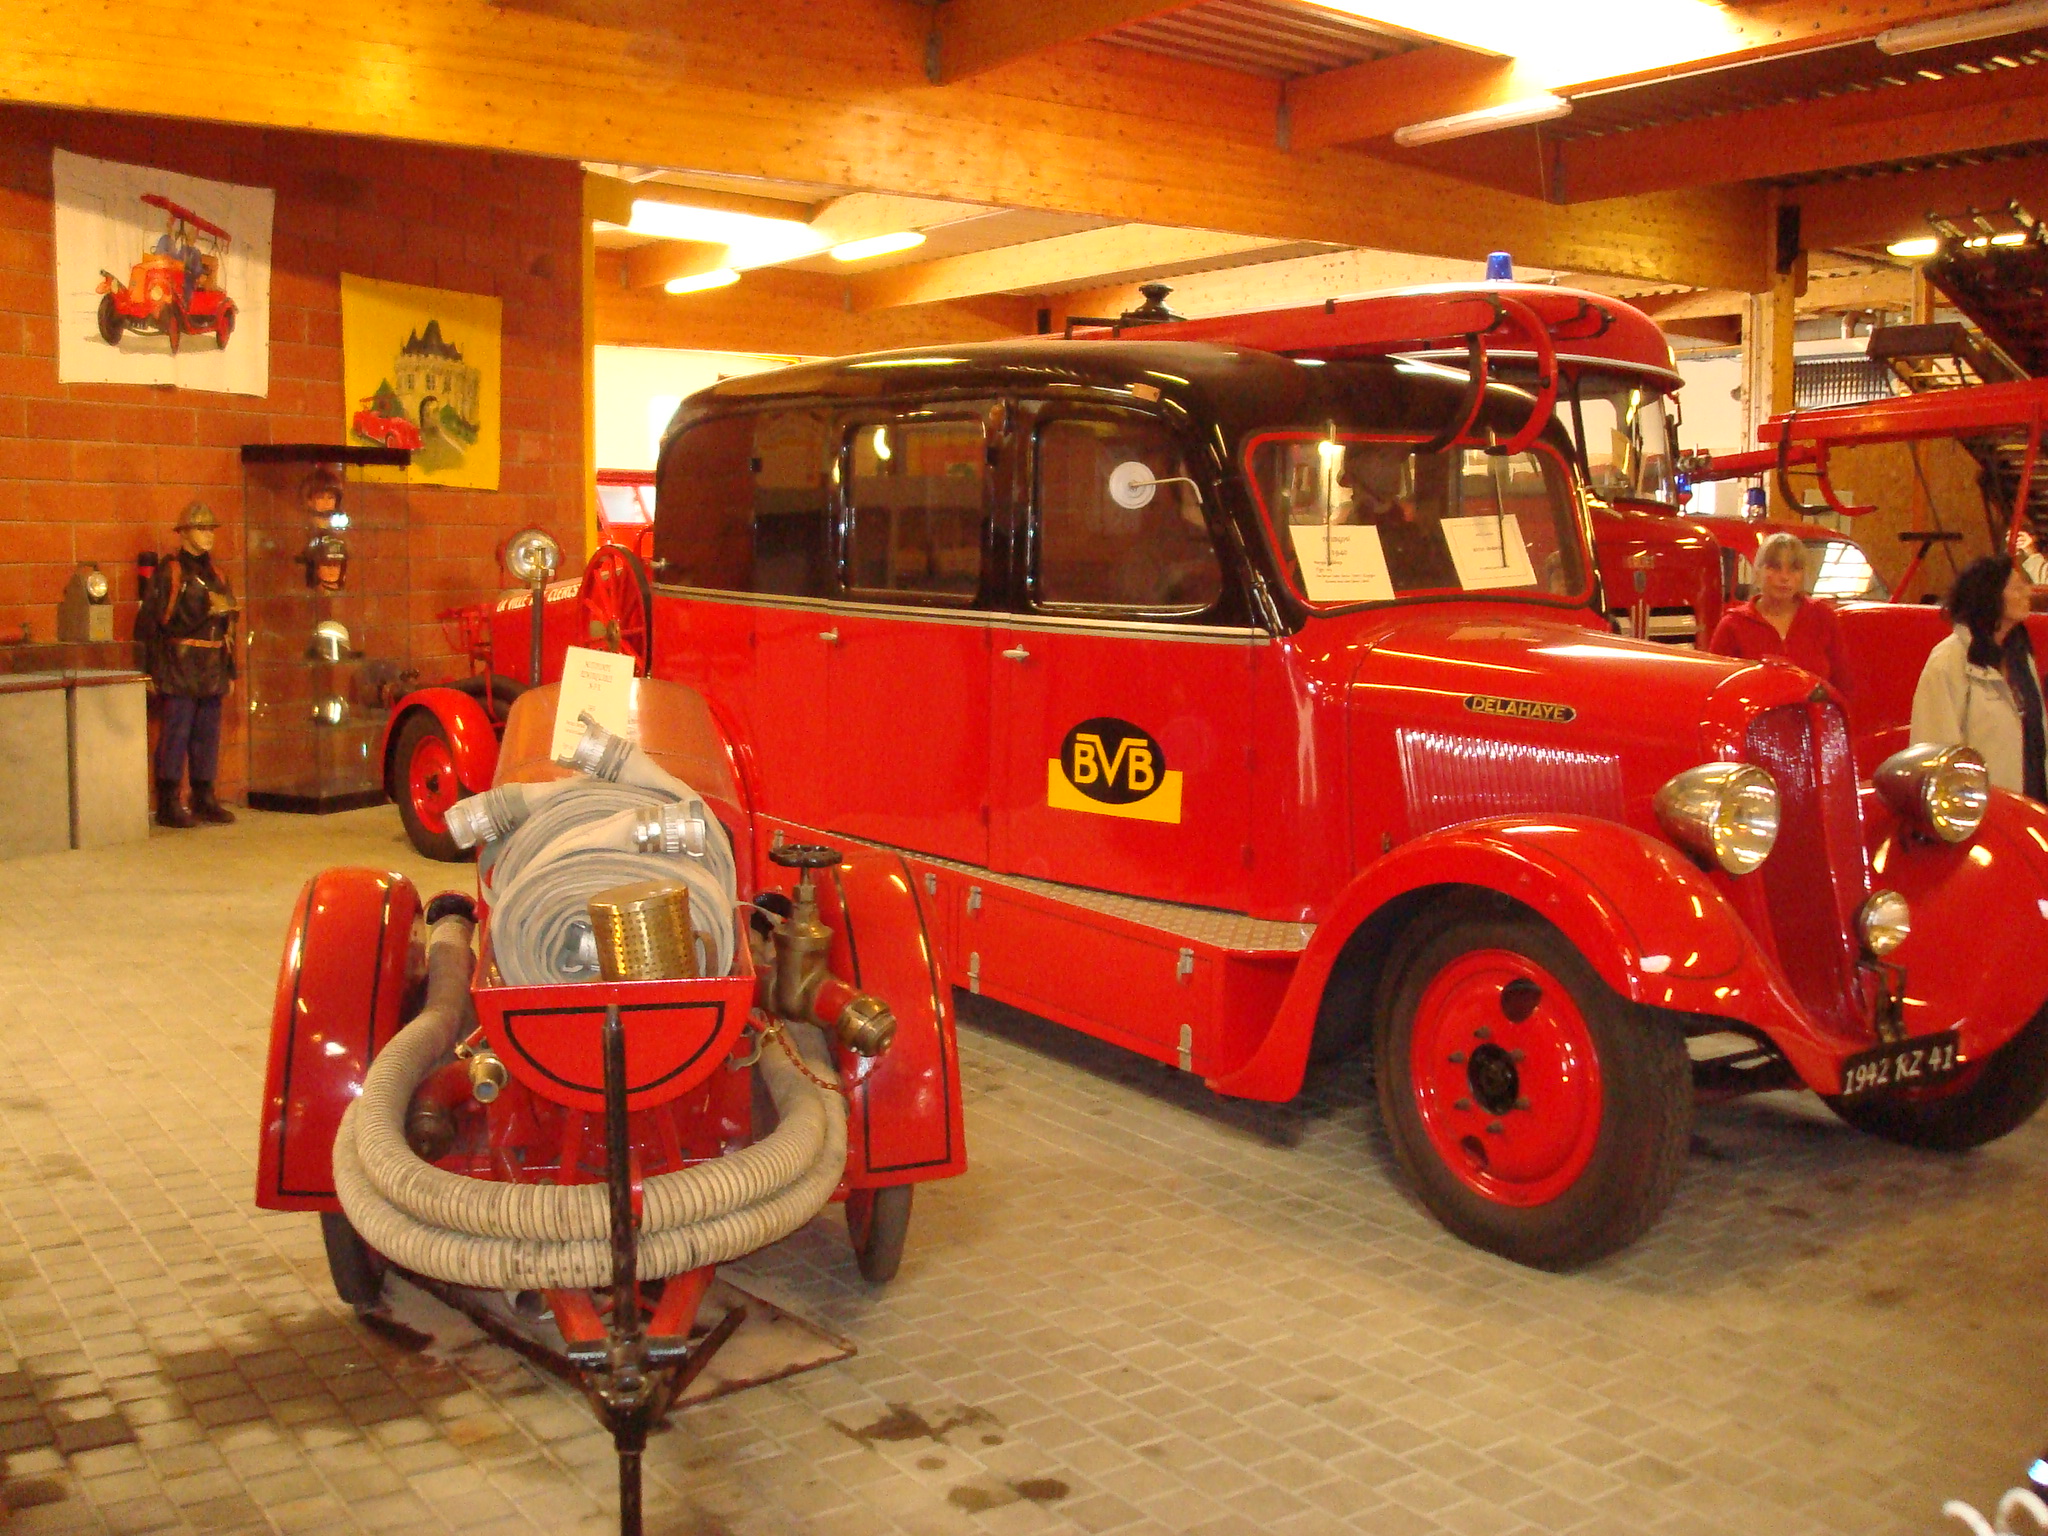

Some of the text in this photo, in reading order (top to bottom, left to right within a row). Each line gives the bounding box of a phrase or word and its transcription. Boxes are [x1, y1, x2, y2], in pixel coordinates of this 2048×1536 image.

[1472, 697, 1566, 721] DELAHAYE
[1074, 732, 1155, 791] BVB
[1843, 1045, 1954, 1095] 1942 RZ 41
